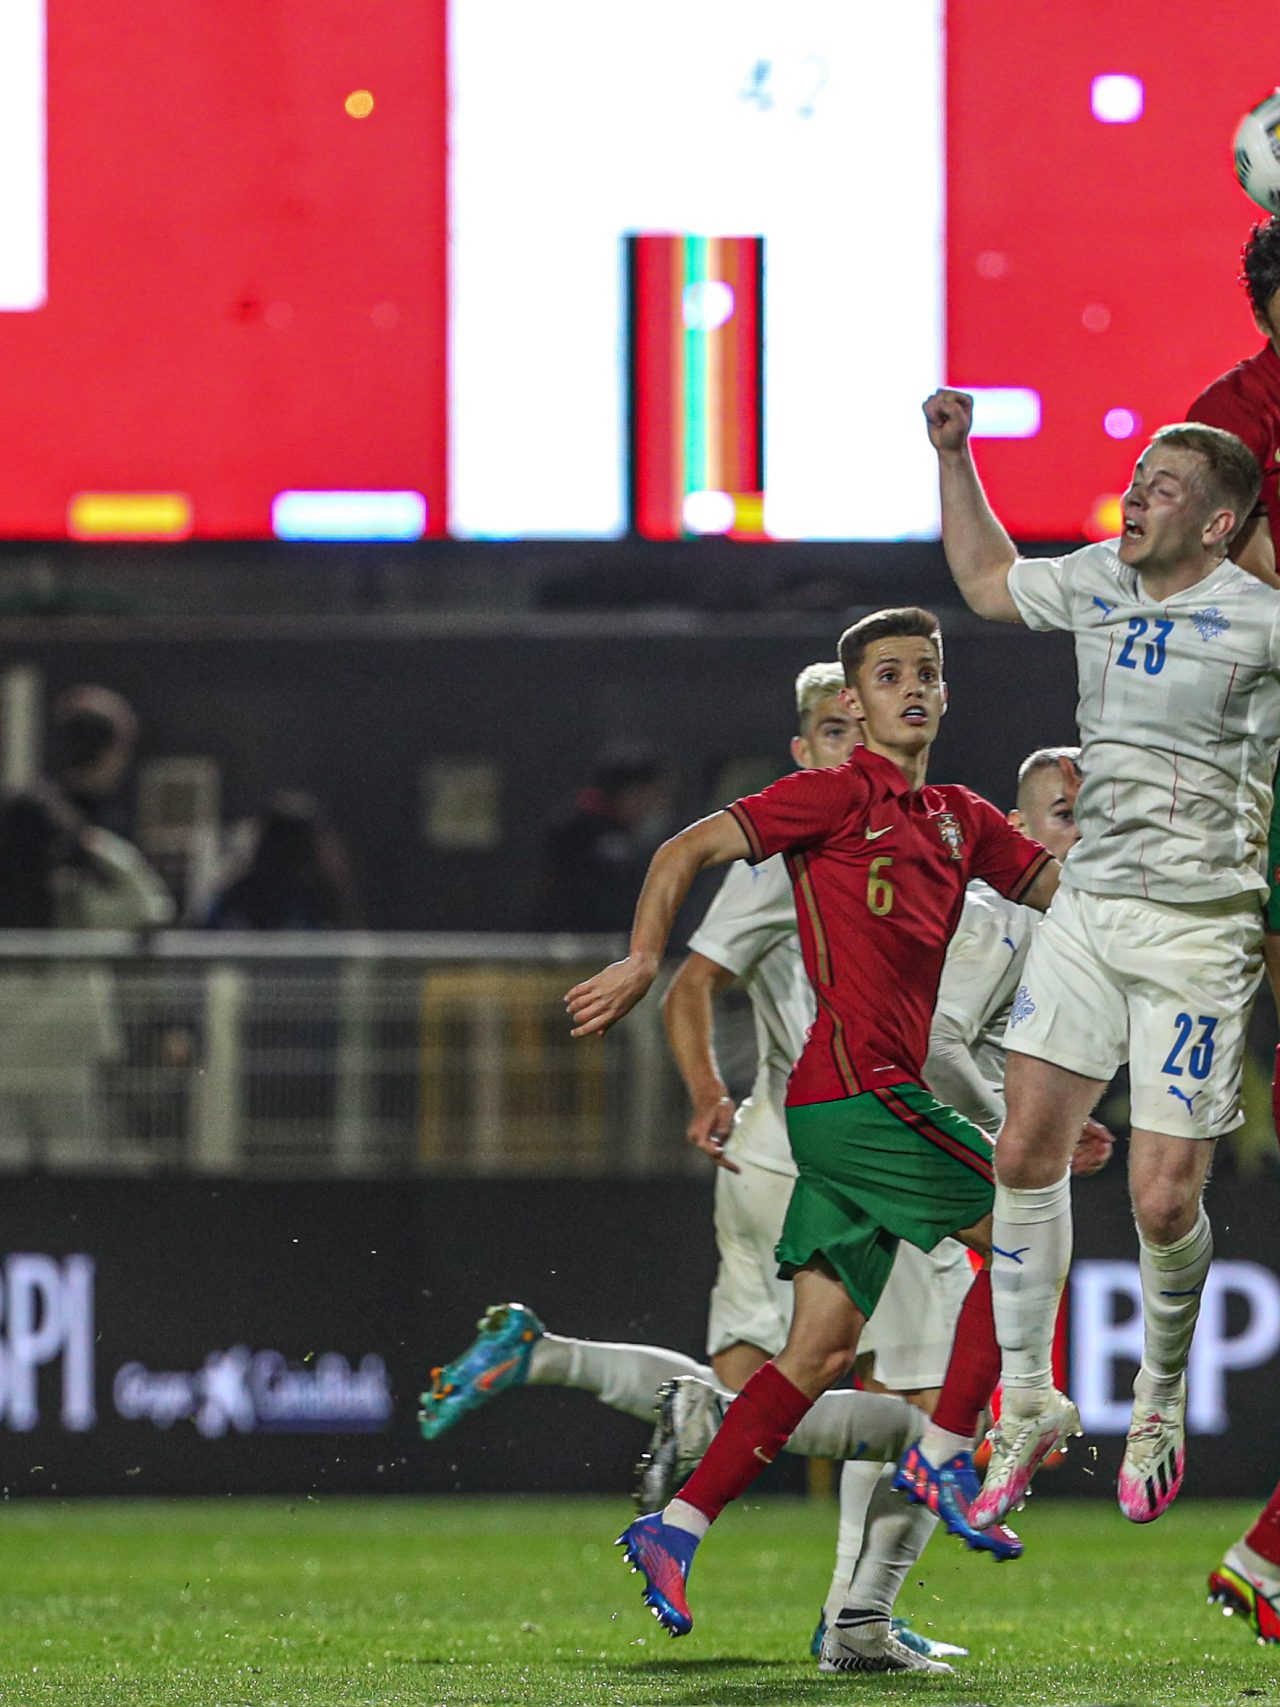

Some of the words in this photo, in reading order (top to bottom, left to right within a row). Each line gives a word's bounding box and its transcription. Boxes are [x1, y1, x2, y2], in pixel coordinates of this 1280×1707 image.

[1115, 616, 1175, 676] 23
[867, 856, 894, 916] 6
[1160, 1012, 1219, 1080] 23
[0, 1252, 97, 1433] PI
